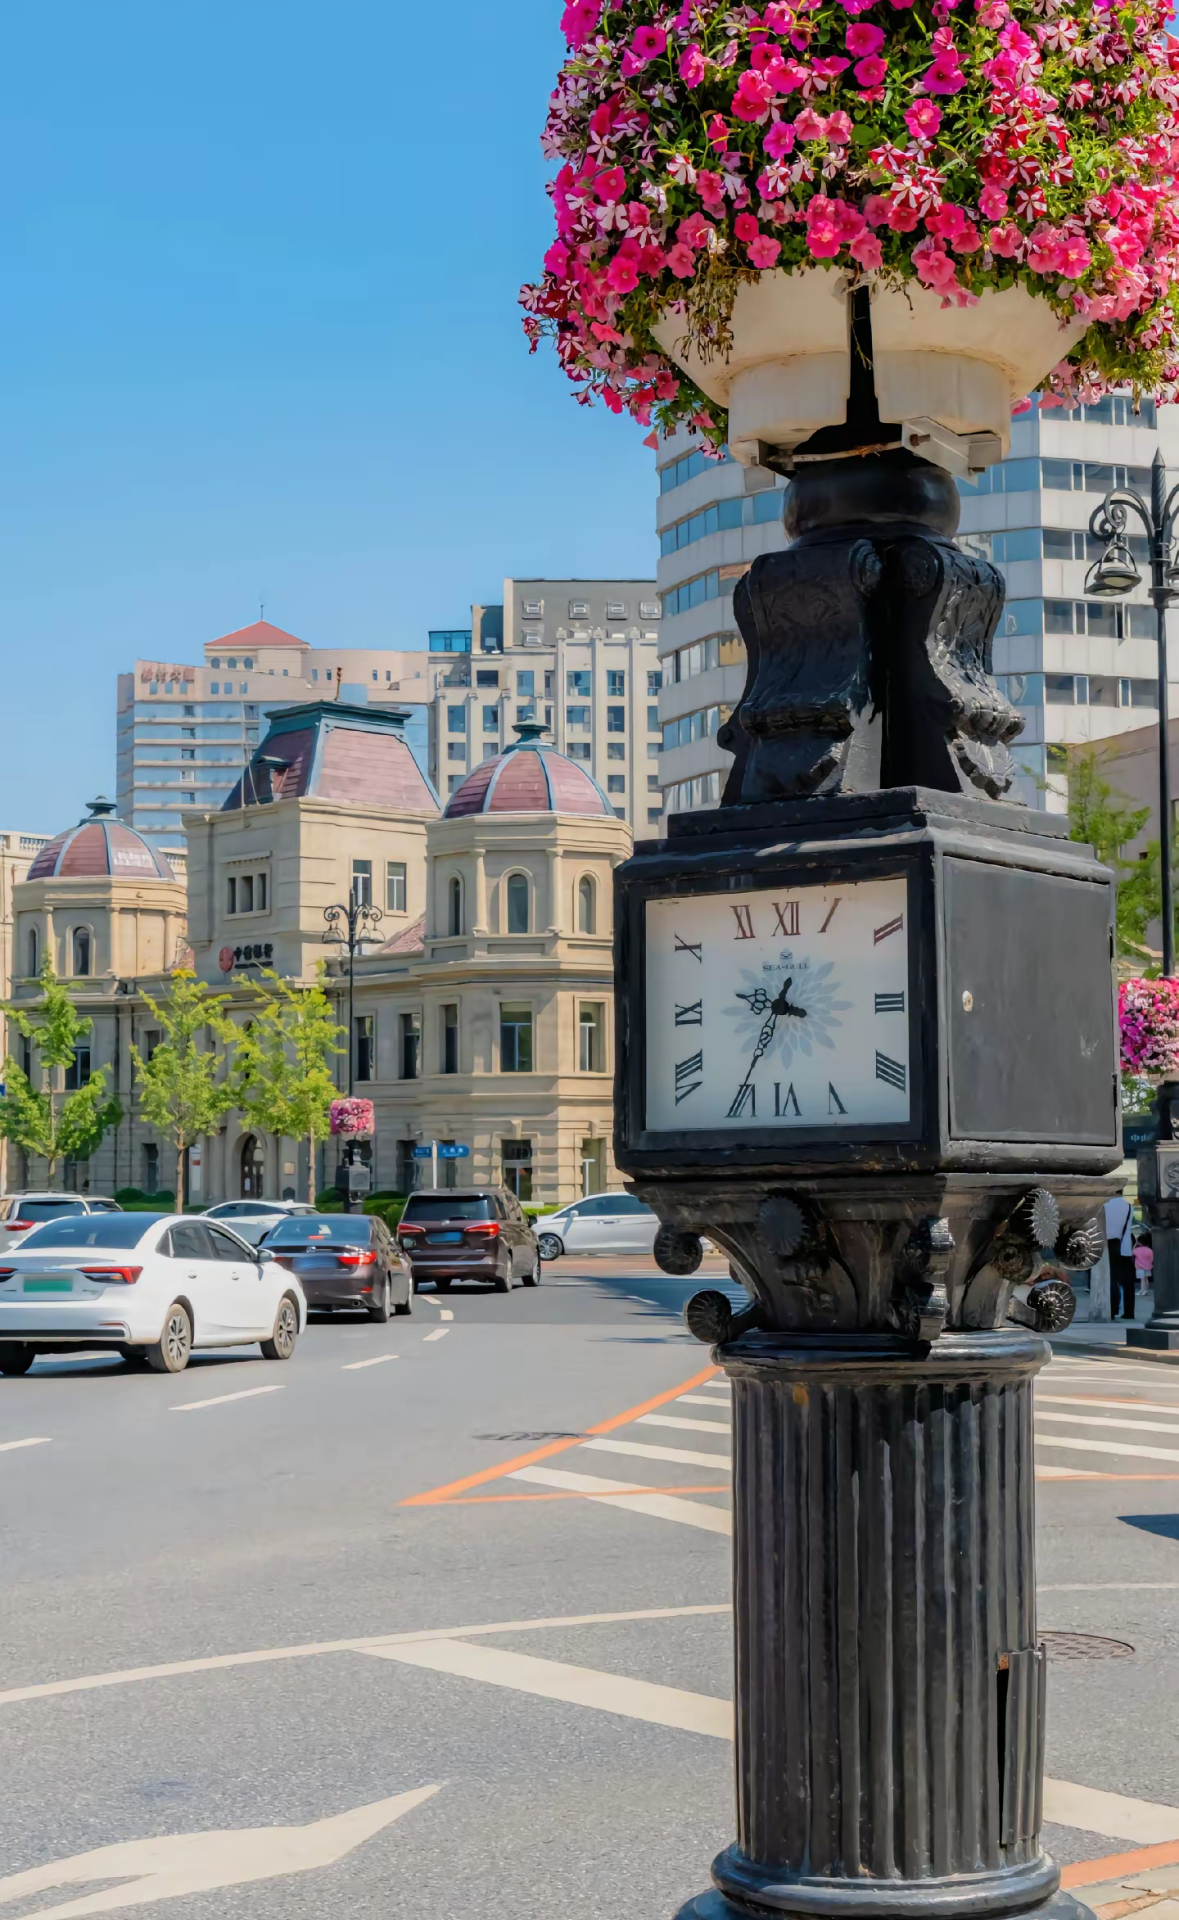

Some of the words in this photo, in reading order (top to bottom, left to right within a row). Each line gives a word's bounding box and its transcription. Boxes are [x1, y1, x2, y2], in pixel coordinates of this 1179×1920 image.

[730, 904, 756, 940] XI
[771, 901, 801, 937] XII
[873, 913, 904, 946] II
[675, 932, 702, 964] X
[874, 991, 905, 1015] III
